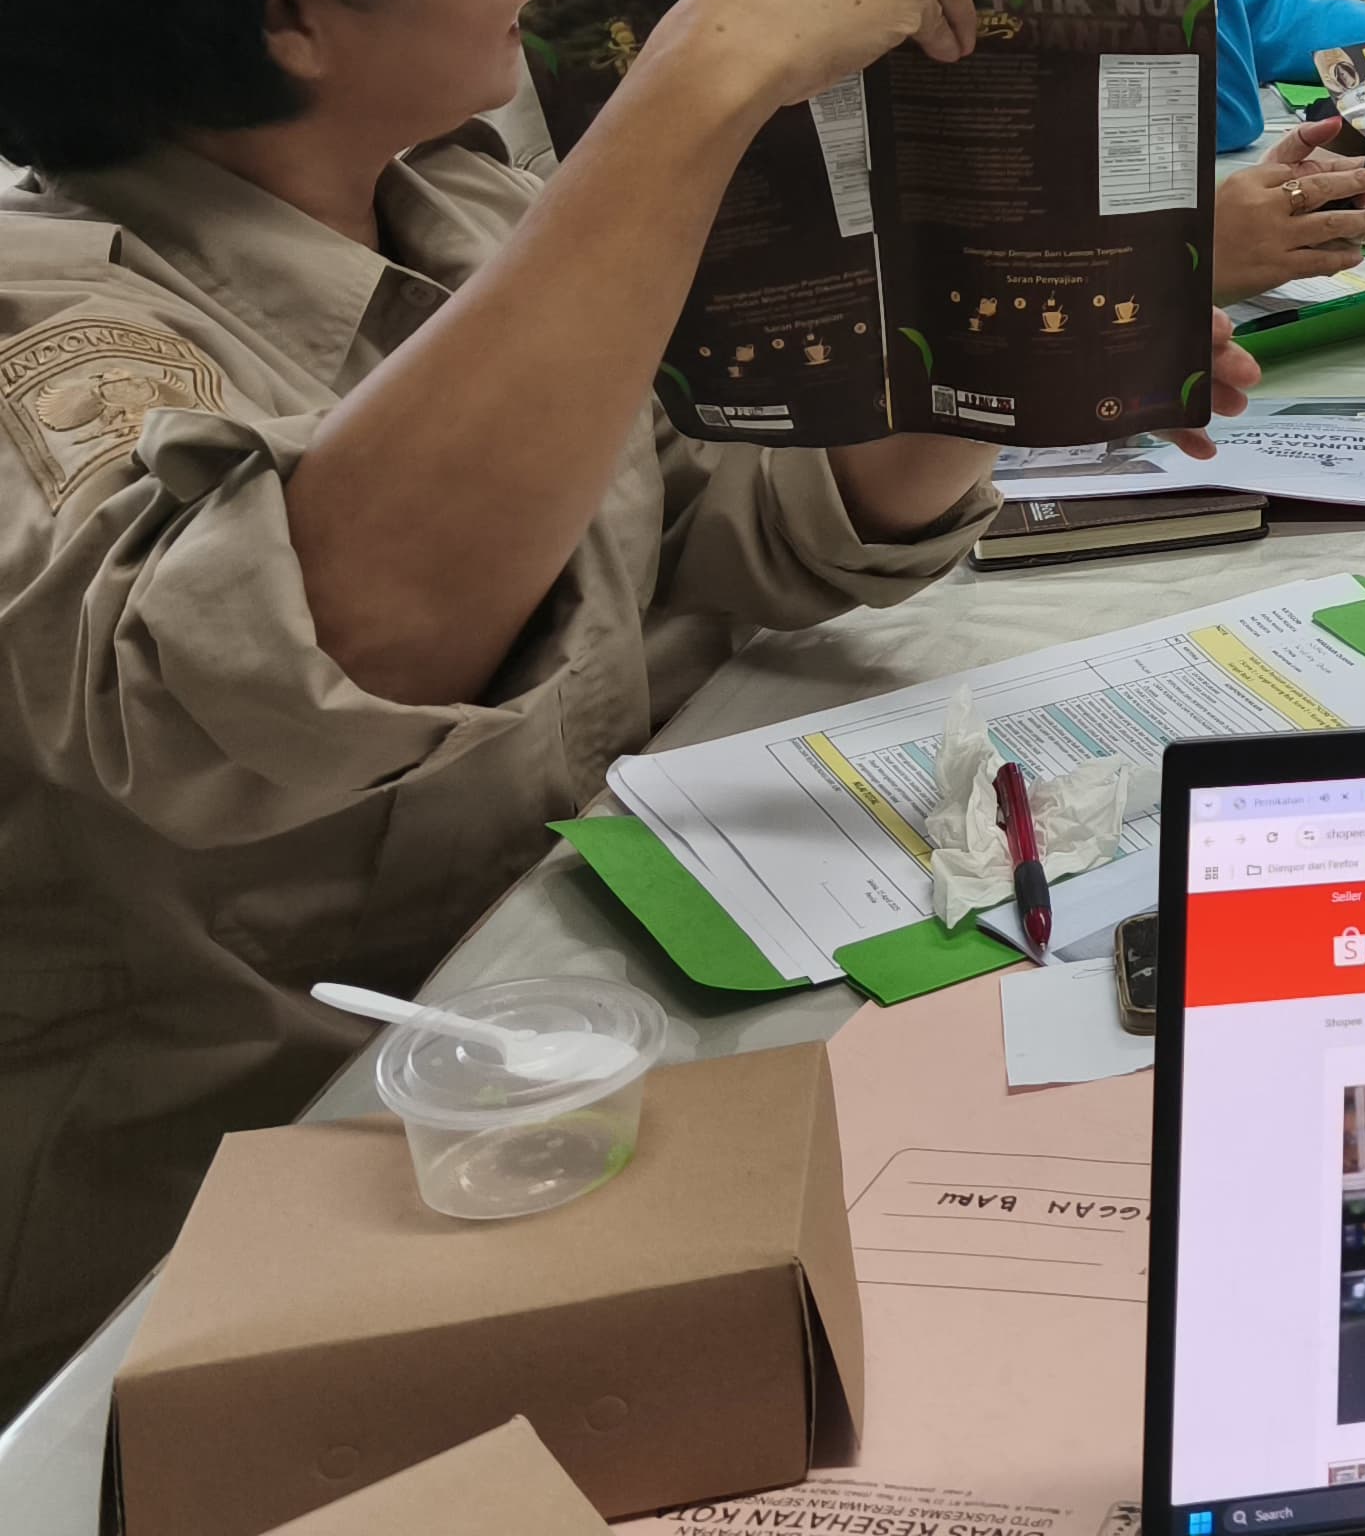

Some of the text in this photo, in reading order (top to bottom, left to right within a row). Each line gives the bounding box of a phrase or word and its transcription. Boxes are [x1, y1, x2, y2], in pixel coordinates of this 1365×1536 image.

[1007, 275, 1083, 286] Saran Penyajian
[1332, 890, 1362, 903] Seller
[938, 1191, 1018, 1213] BARU
[806, 1500, 1053, 1529] UPTD PUSKESMAS PERAWATAN
[1255, 1505, 1293, 1524] Search
